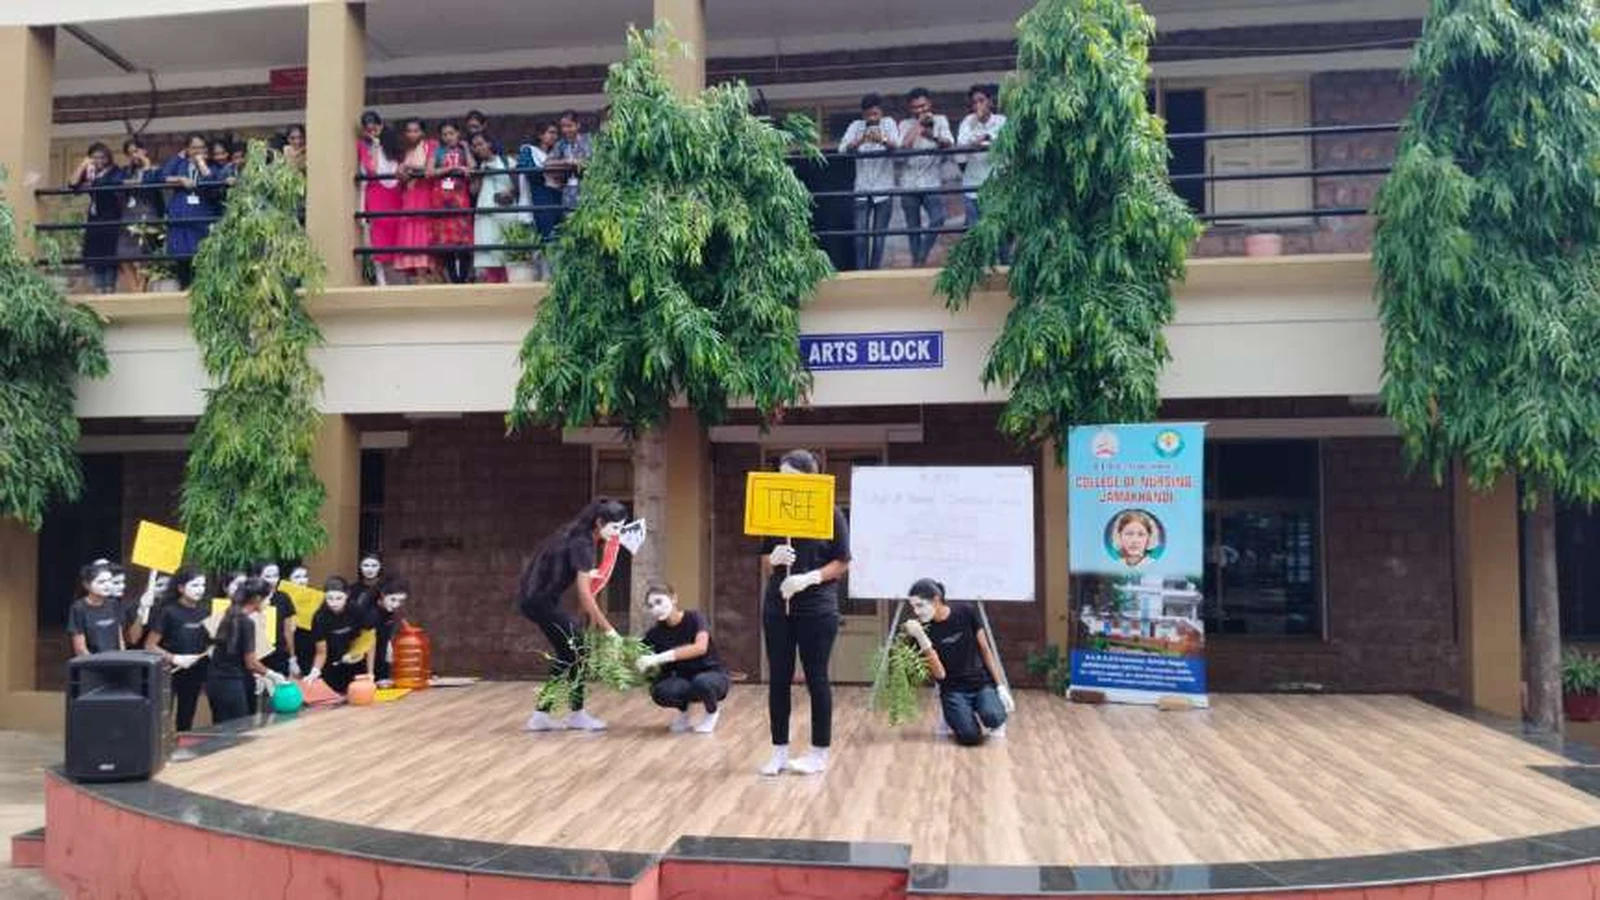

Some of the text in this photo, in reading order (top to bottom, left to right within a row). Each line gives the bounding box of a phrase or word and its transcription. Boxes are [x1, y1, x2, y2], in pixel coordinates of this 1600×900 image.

[808, 339, 931, 364] ARTS BLOCK
[1076, 475, 1118, 488] COLLEGE
[1123, 475, 1135, 487] OF
[764, 487, 817, 522] TREE
[1099, 490, 1173, 503] JAMAKHANDI
